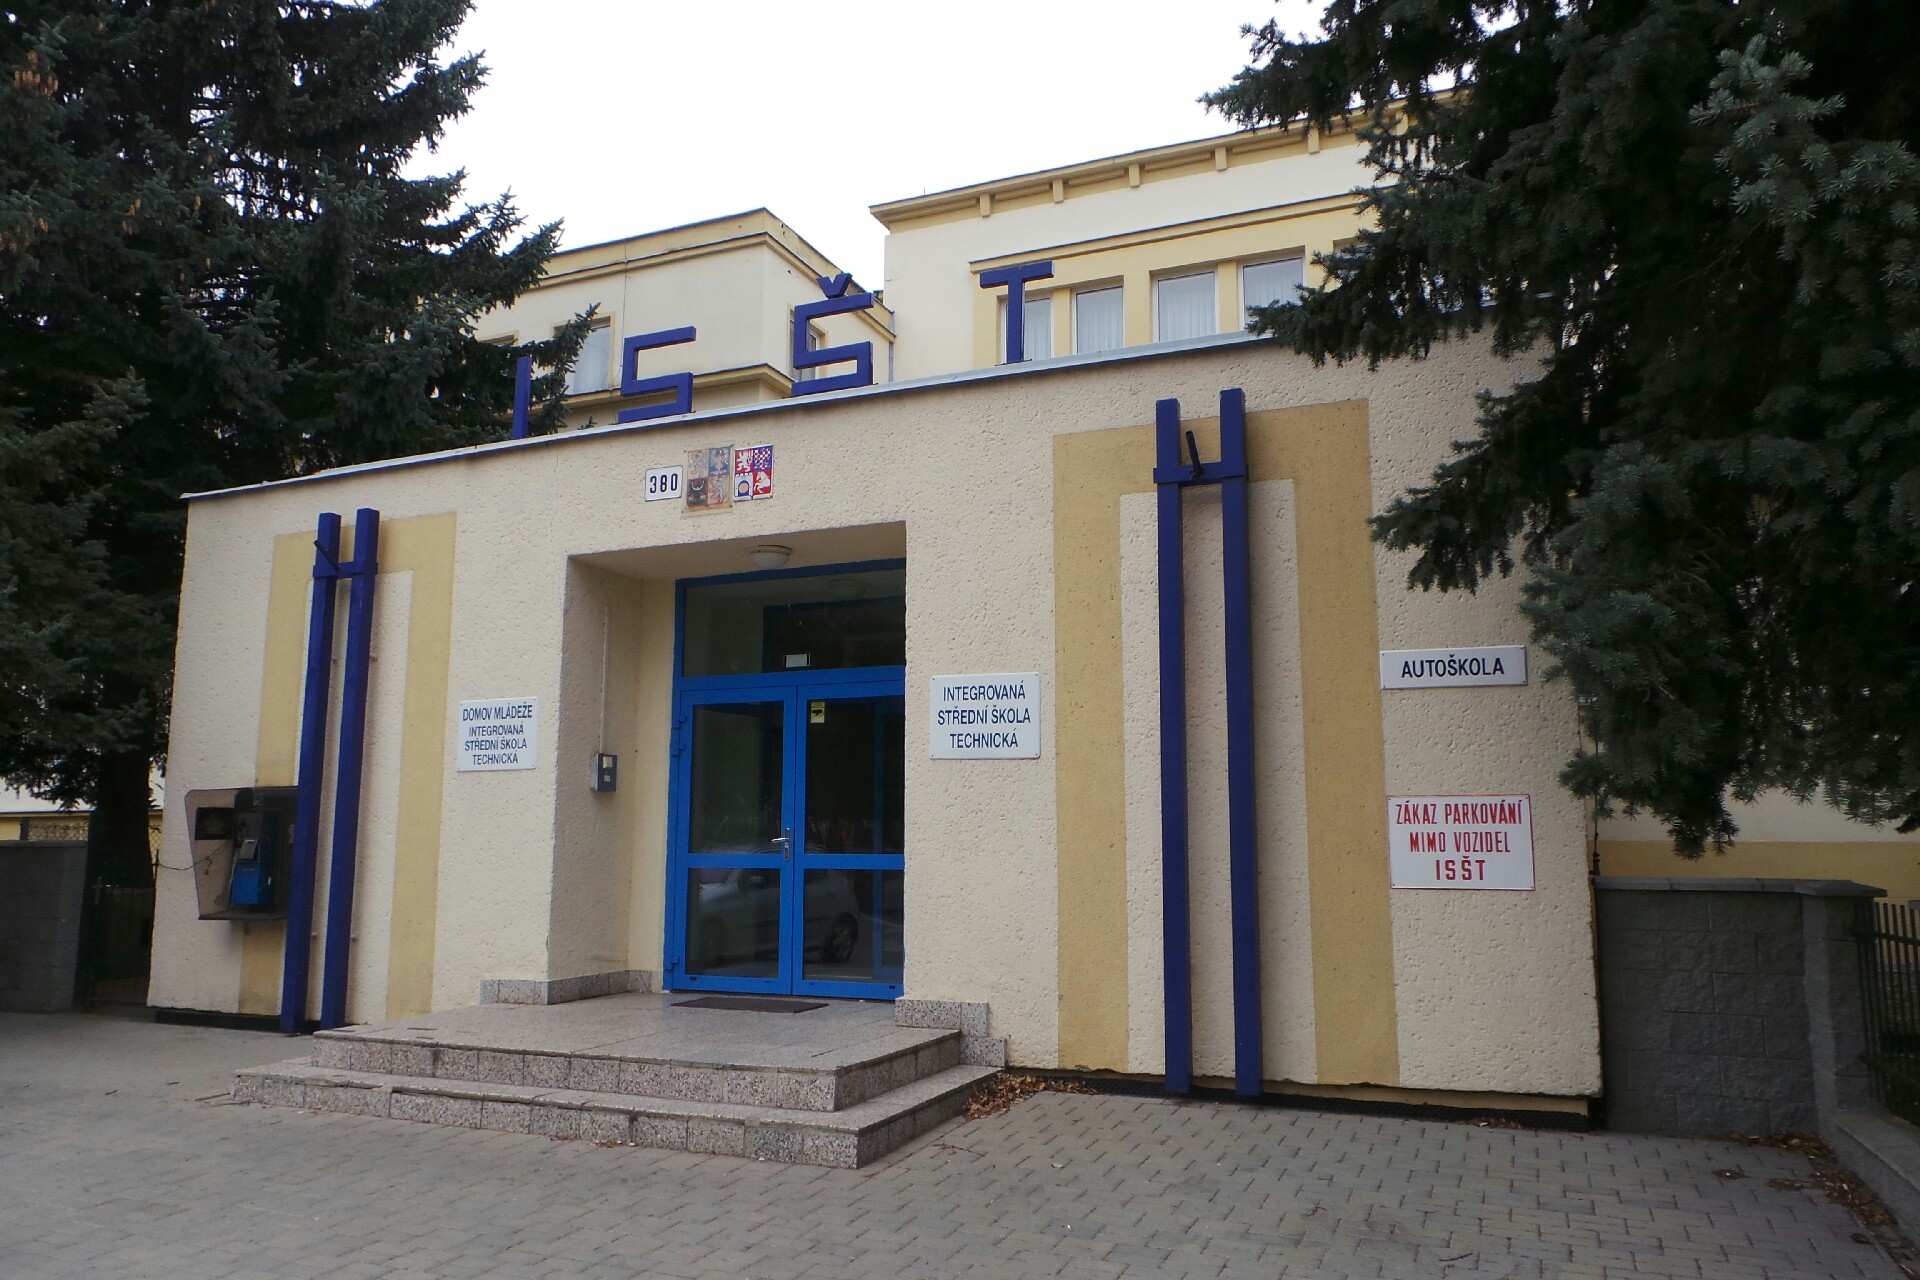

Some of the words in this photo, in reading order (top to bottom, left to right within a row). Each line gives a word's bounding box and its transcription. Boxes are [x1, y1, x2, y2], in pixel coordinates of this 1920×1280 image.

[511, 260, 1054, 440] ISŠT
[650, 473, 678, 493] 380
[1401, 654, 1505, 678] AUTOŠKOLA
[943, 680, 1025, 701] INTEGROVANÁ
[463, 707, 492, 721] DOMOV
[494, 702, 532, 719] MLÁDEŽE
[938, 705, 988, 725] STŘEDNÍ
[991, 705, 1031, 723] ŠKOLA
[469, 721, 524, 736] INTEGROVANÁ
[950, 728, 1018, 748] TECHNICKÁ
[465, 736, 498, 751] STŘEDNÍ
[500, 736, 527, 750] ŠKOLA
[473, 750, 518, 765] TECHNICKÁ
[1396, 801, 1437, 824] ZÁKAZ
[1445, 800, 1523, 824] PARKOVÁNÍ
[1410, 832, 1445, 853] MIMO
[1454, 831, 1510, 853] VOZIDEL
[1436, 856, 1486, 880] ISŠT
